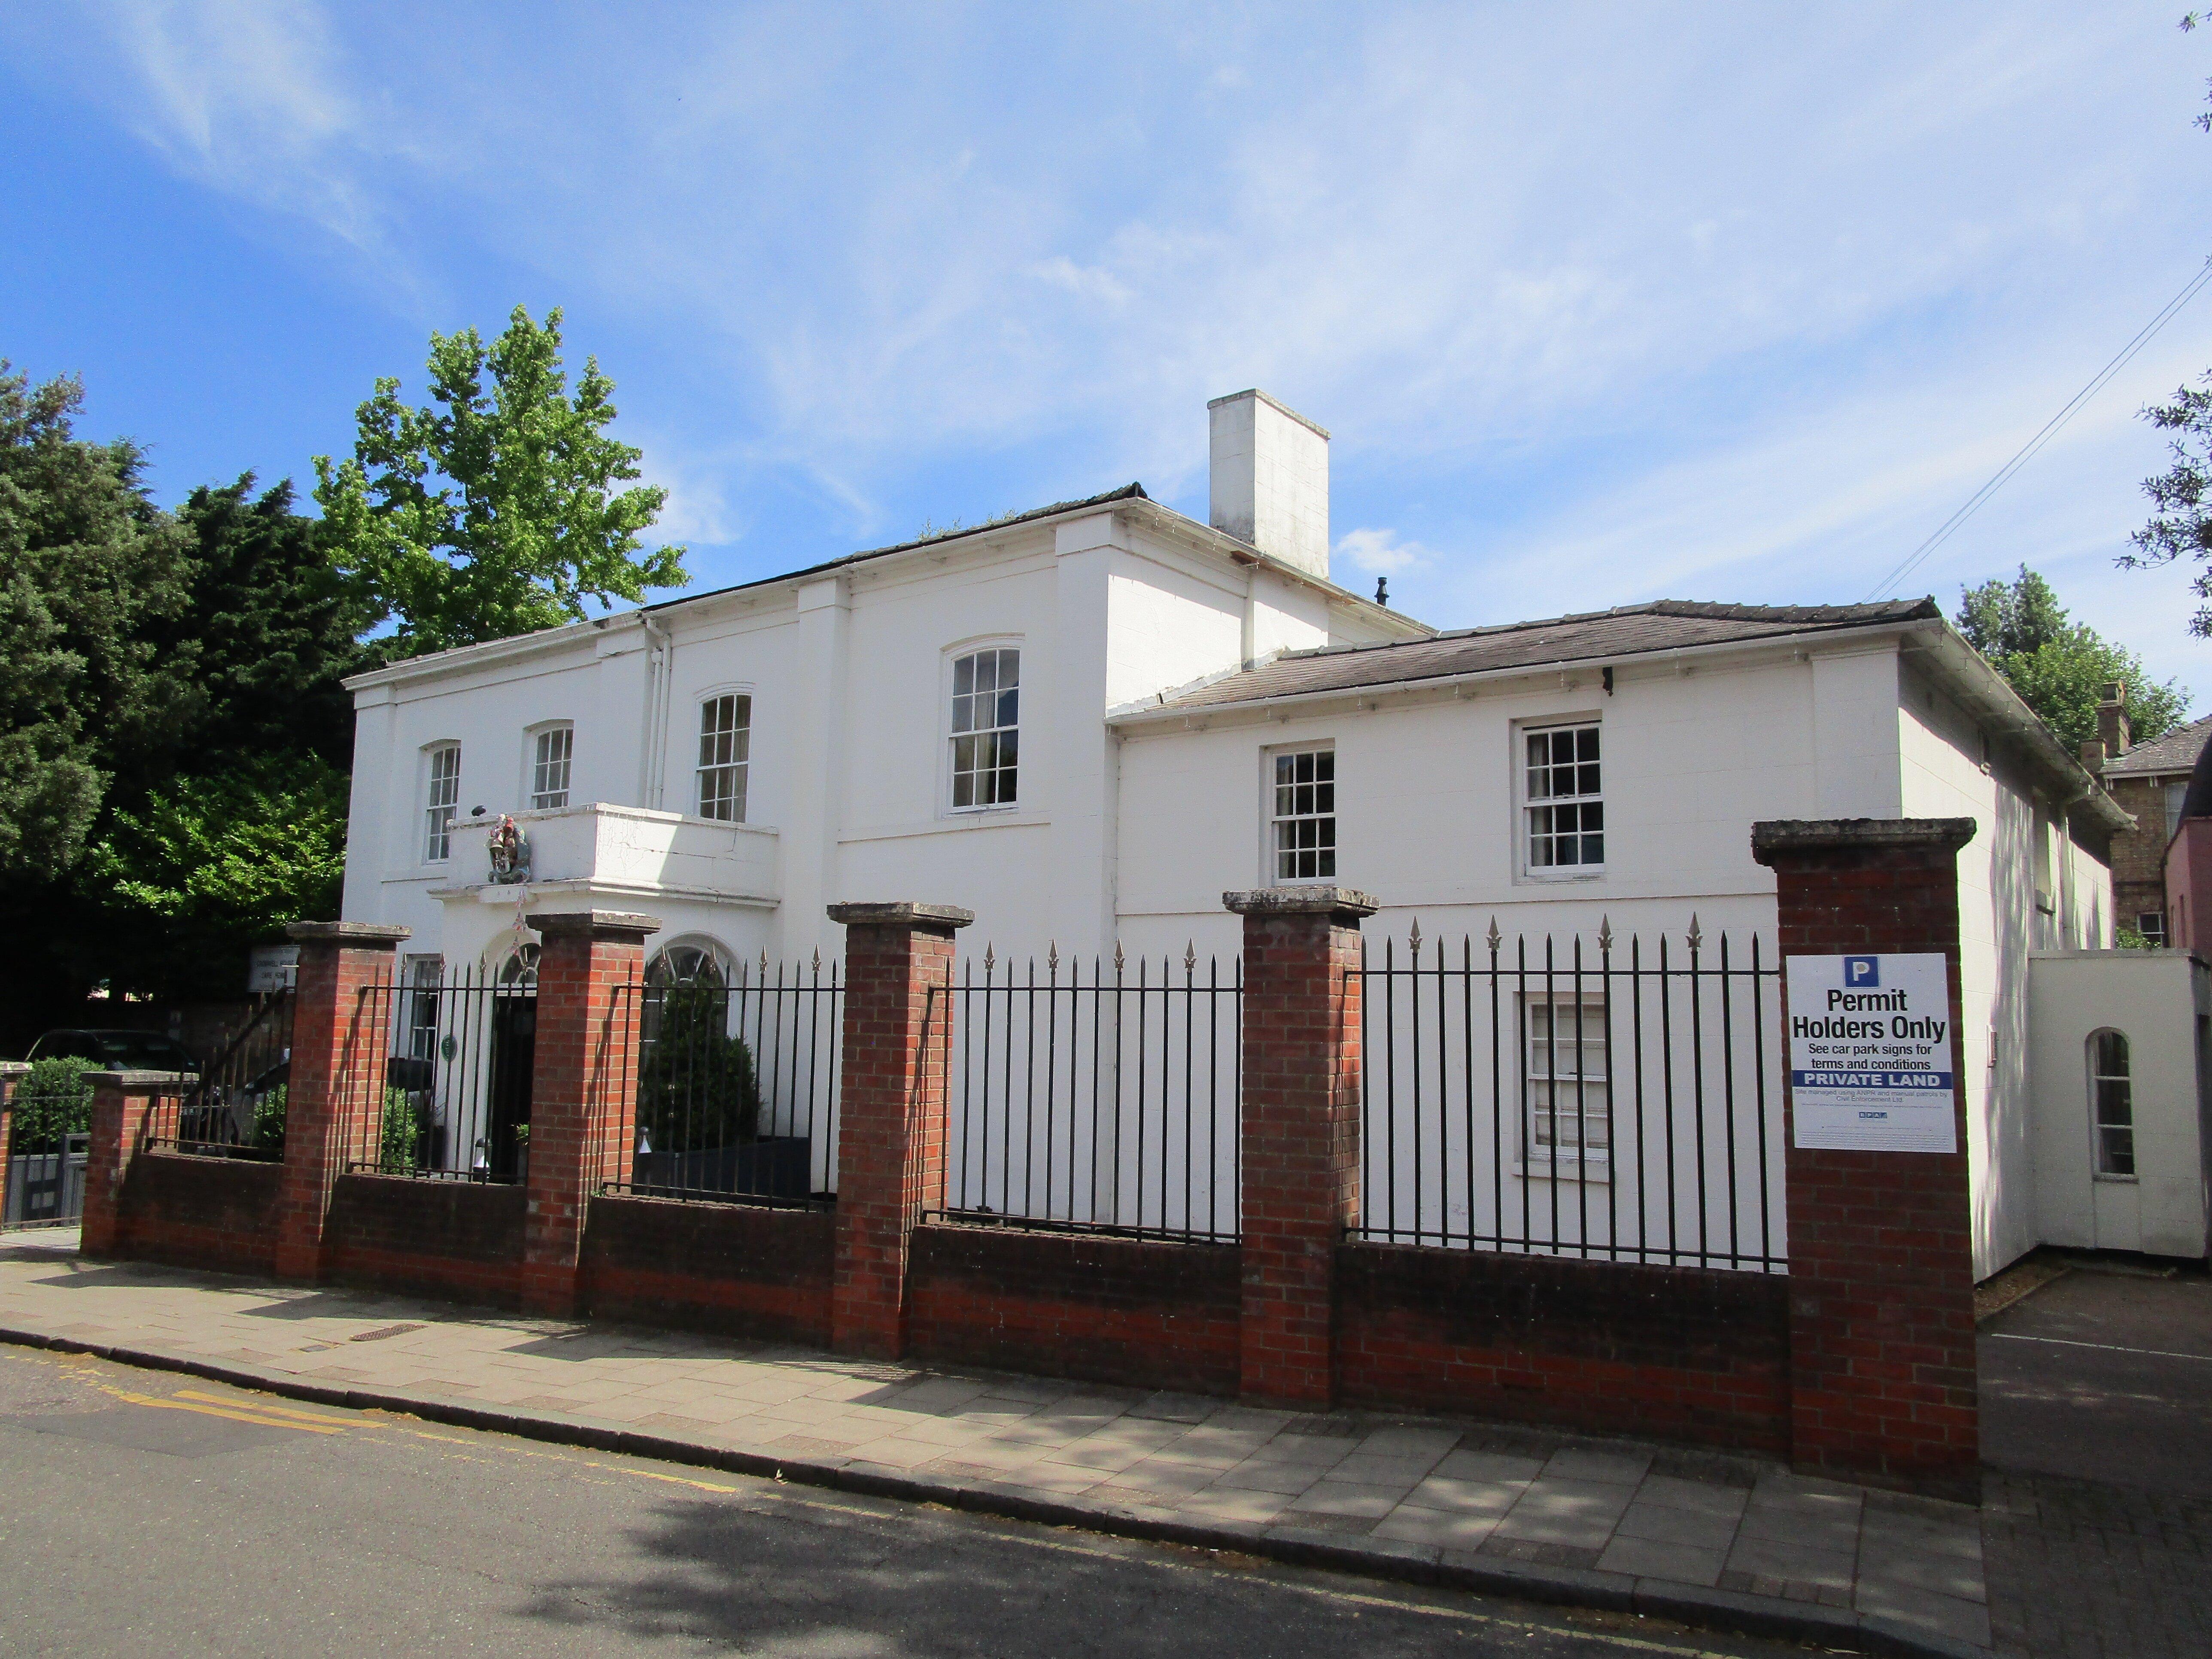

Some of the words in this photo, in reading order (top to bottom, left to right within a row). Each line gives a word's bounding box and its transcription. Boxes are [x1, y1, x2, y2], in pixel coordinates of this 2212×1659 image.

[1853, 961, 1869, 981] P
[1828, 988, 1908, 1012] Permit
[1793, 1016, 1884, 1039] Holders
[1892, 1015, 1946, 1044] Only
[1808, 1043, 1829, 1054] See
[1832, 1045, 1850, 1054] car
[1853, 1044, 1879, 1056] park
[1882, 1044, 1913, 1057] signs
[1916, 1044, 1932, 1054] for
[1811, 1058, 1844, 1069] terms
[1847, 1059, 1867, 1069] and
[1872, 1059, 1931, 1070] conditions
[1805, 1073, 1883, 1086] PRIVATE
[1889, 1075, 1940, 1087] LAND
